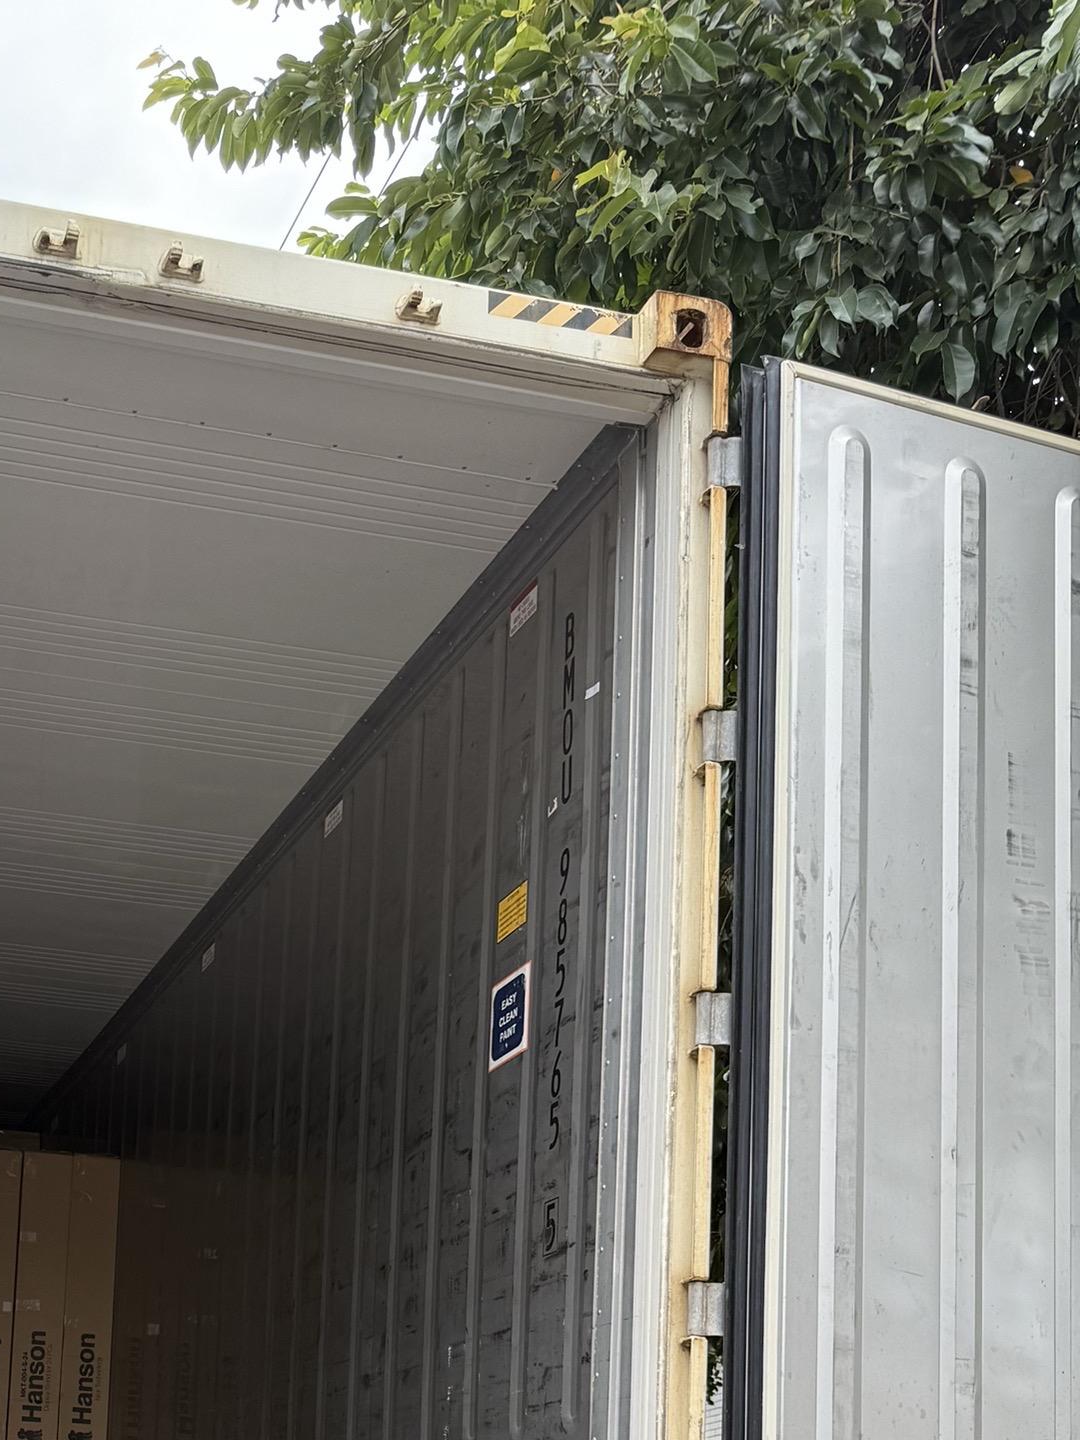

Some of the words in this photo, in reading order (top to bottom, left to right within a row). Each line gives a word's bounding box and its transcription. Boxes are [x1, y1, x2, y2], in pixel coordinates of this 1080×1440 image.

[560, 612, 575, 804] BMOU
[498, 1007, 519, 1028] CLEAN
[499, 1024, 517, 1043] PAINT
[500, 992, 518, 1010] EASY
[549, 848, 570, 1150] 985765
[546, 1203, 557, 1252] 5
[22, 1331, 46, 1422] Hanson
[72, 1333, 95, 1424] Hanson
